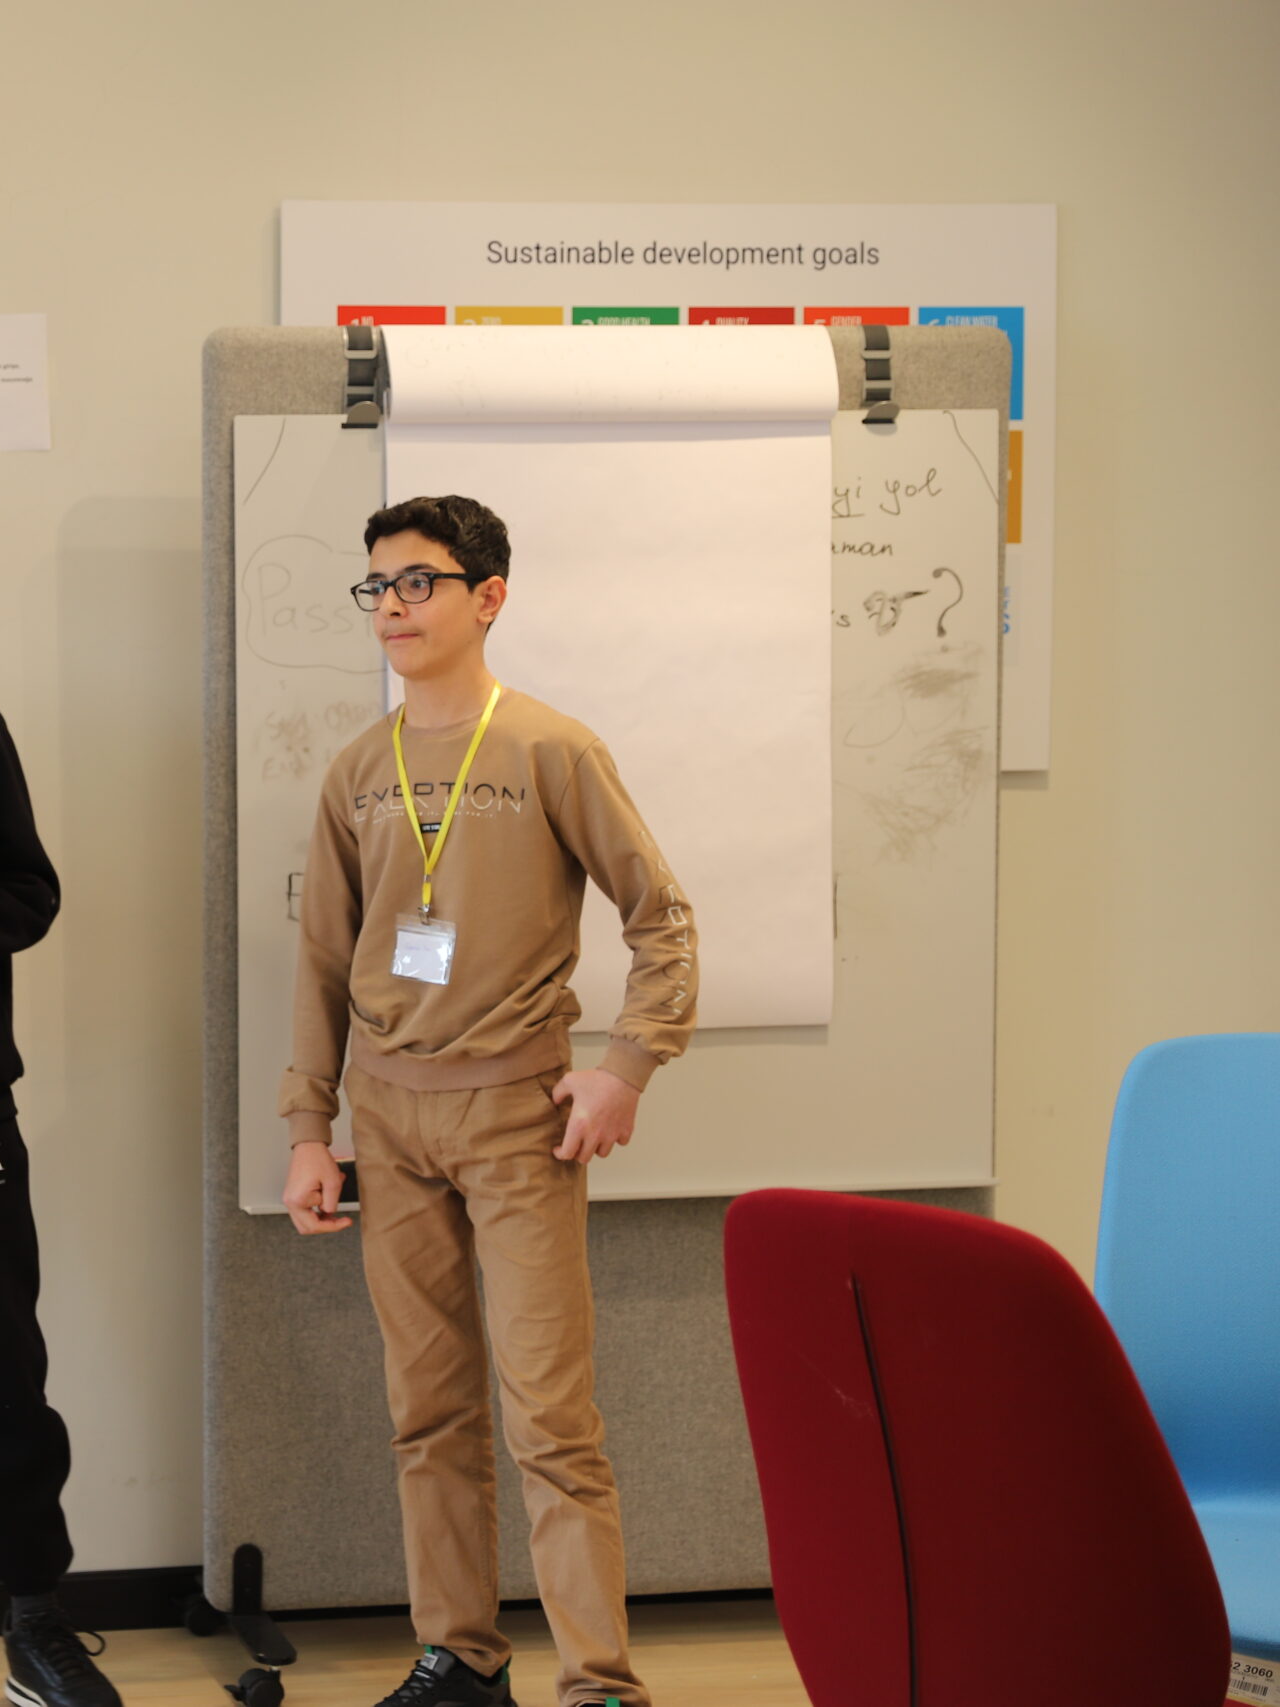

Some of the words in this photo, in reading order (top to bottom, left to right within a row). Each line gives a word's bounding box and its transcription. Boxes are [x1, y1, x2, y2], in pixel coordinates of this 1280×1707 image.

[487, 239, 635, 266] Sustainable
[642, 239, 805, 271] development
[812, 239, 880, 271] goals
[1243, 1664, 1274, 1678] 3060
